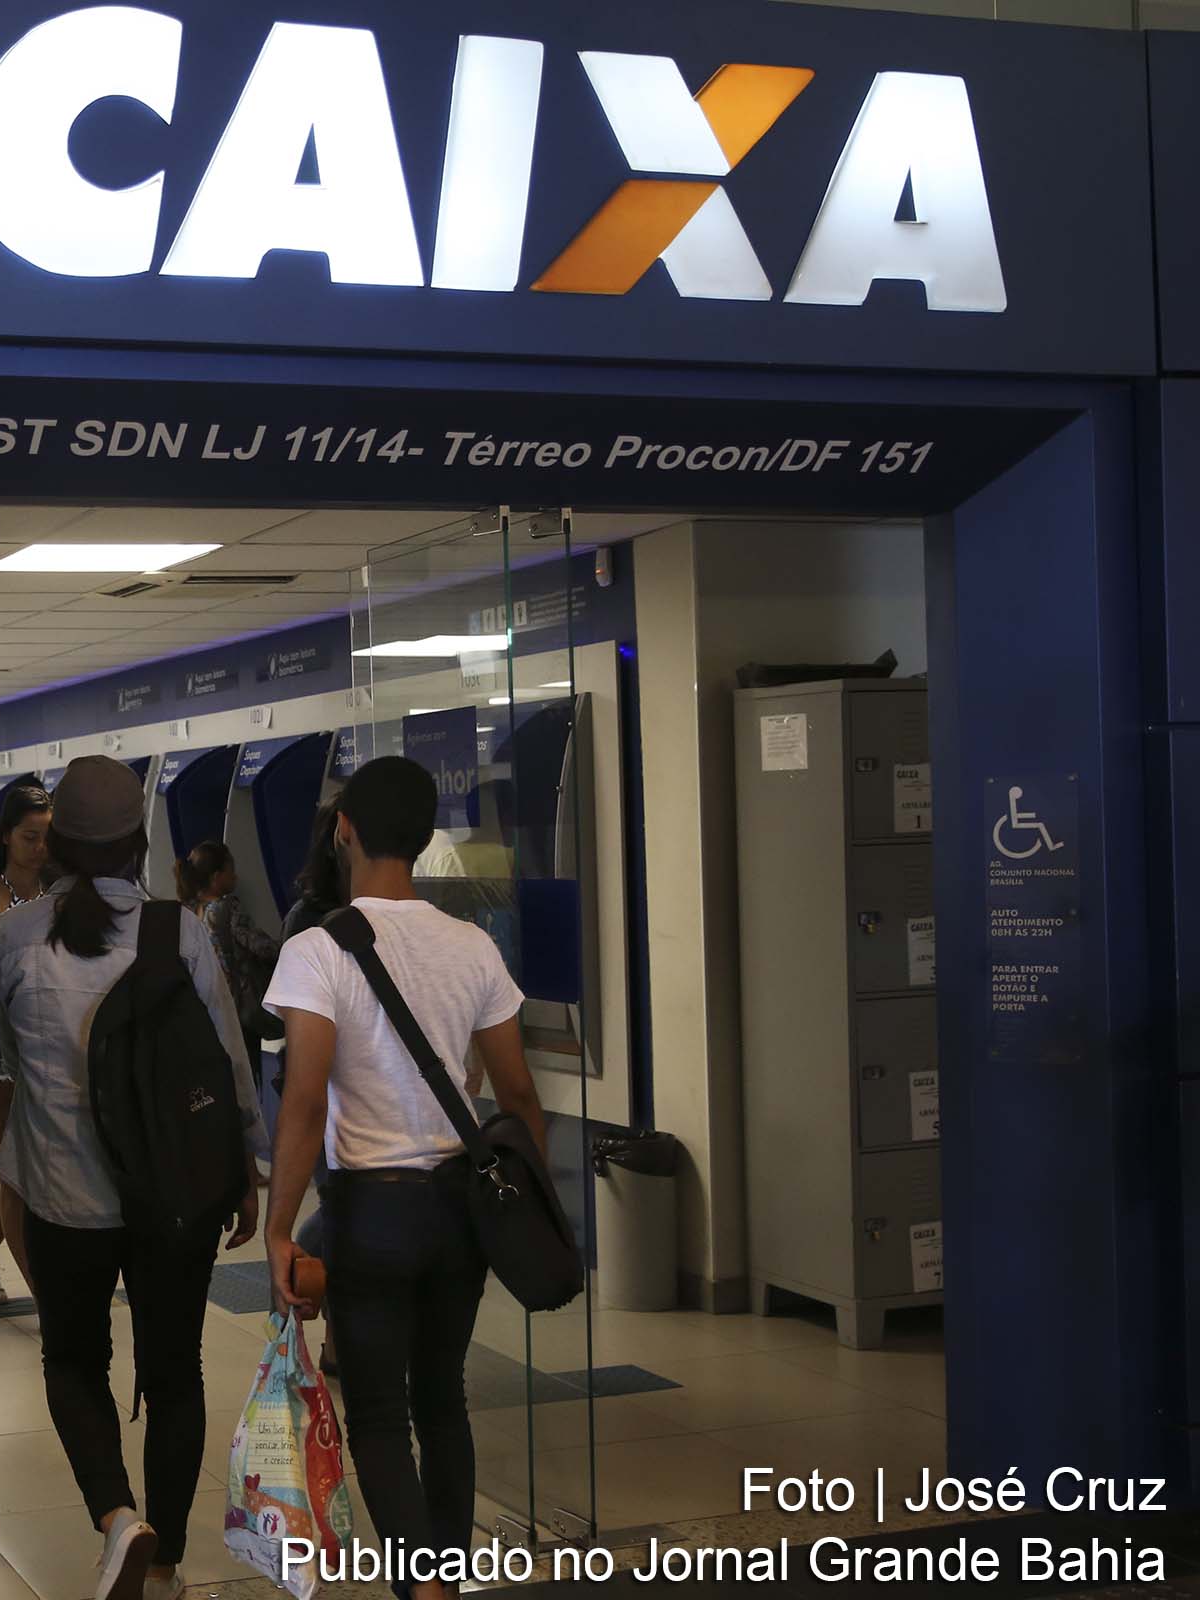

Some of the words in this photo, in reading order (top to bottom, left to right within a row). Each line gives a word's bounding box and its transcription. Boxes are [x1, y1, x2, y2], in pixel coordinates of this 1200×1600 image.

[69, 419, 189, 458] SDN
[201, 424, 267, 460] LJ
[285, 426, 424, 464] 11/14-
[443, 431, 593, 468] Térreo
[604, 435, 851, 472] Procon/DF
[860, 441, 934, 473] 151
[990, 909, 1018, 917] AUTO
[991, 918, 1064, 927] ATENDIMENTO
[1031, 928, 1053, 936] 22H
[992, 965, 1018, 973] PARA
[1020, 965, 1059, 973] ENTRAR
[992, 974, 1028, 982] APERTE
[1029, 974, 1039, 983] O
[992, 994, 1039, 1002] EMPURRE
[1040, 994, 1049, 1003] A
[992, 1003, 1025, 1011] PORTA
